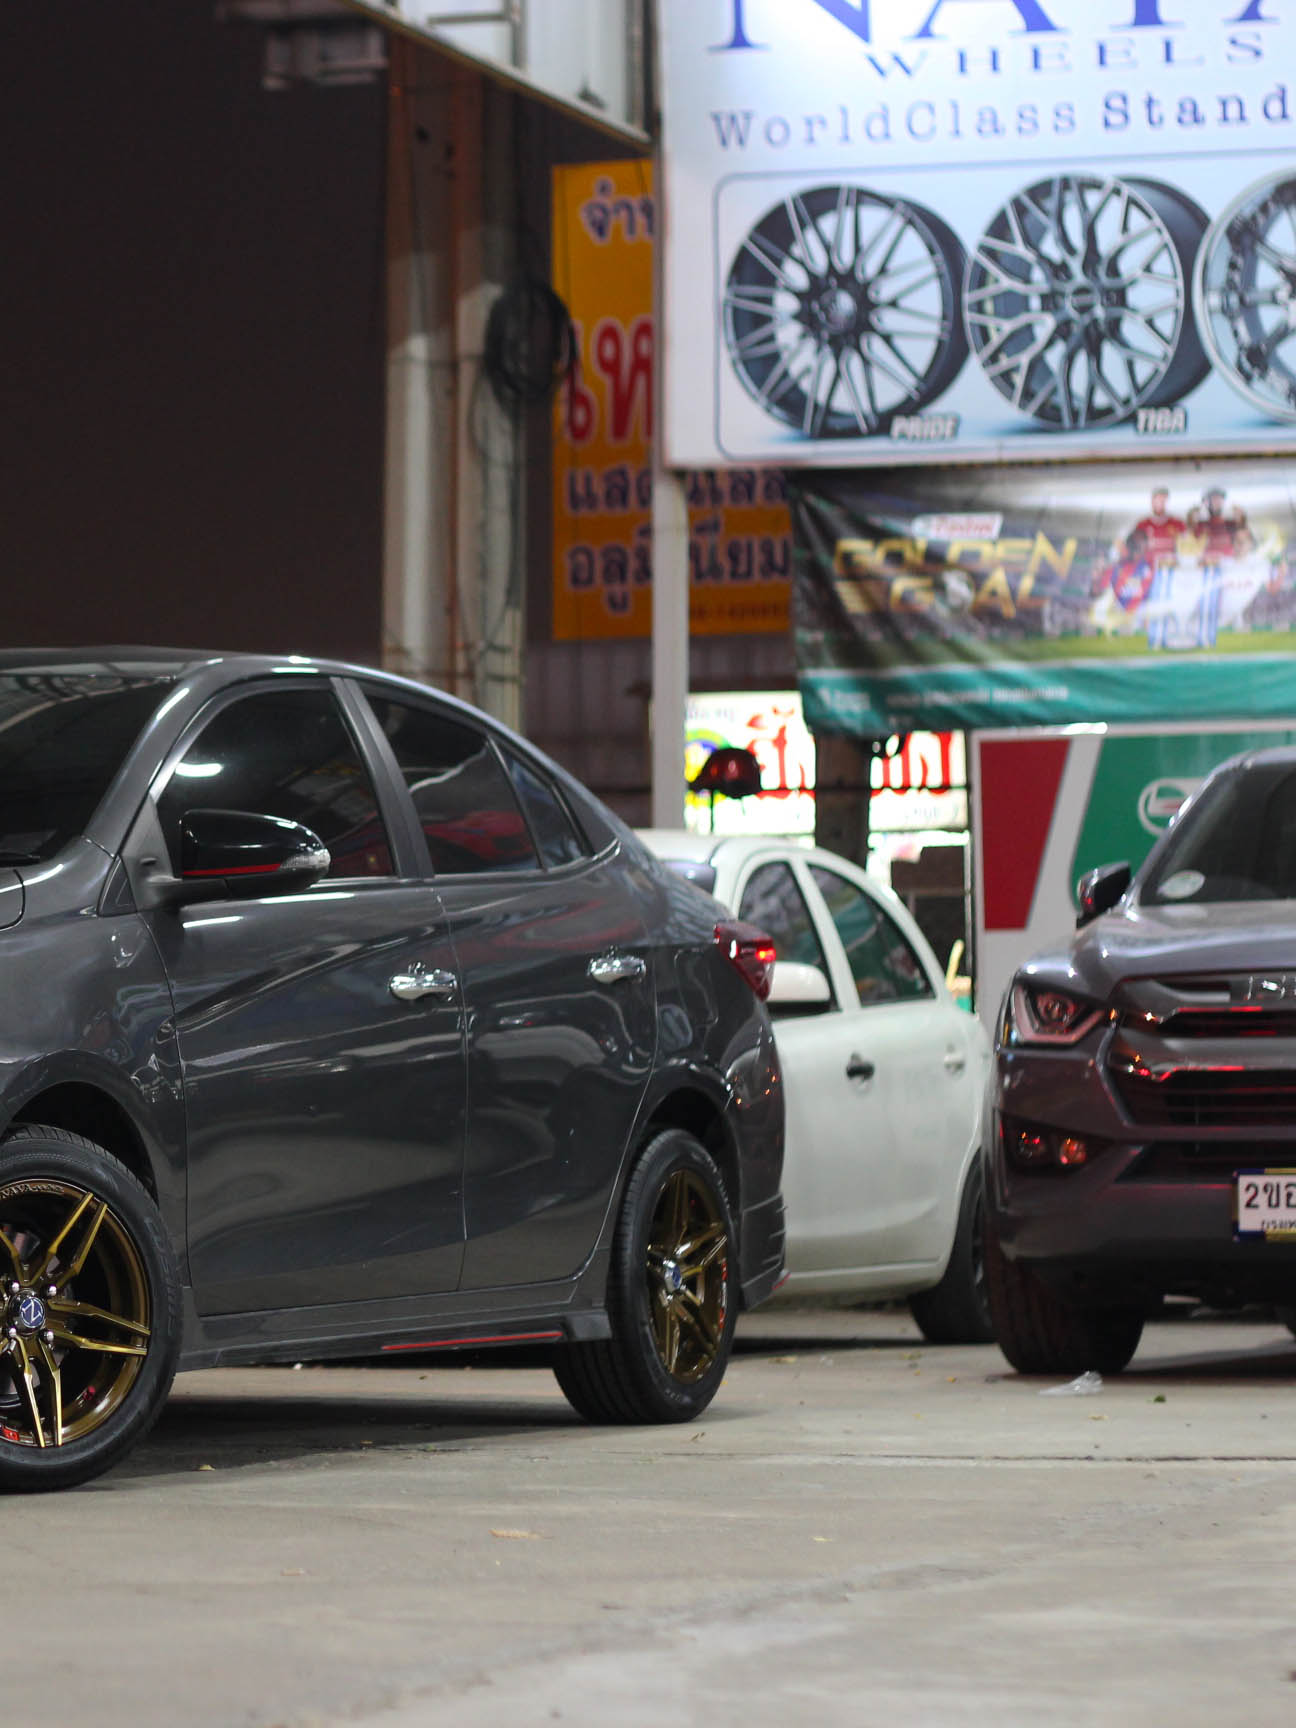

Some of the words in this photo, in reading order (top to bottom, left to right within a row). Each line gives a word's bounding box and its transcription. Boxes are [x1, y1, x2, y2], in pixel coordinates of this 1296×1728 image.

[864, 31, 1264, 79] WHEELS
[710, 99, 1077, 151] WorldClass
[890, 414, 959, 440] PRIDE
[834, 532, 1077, 580] GOLDEN
